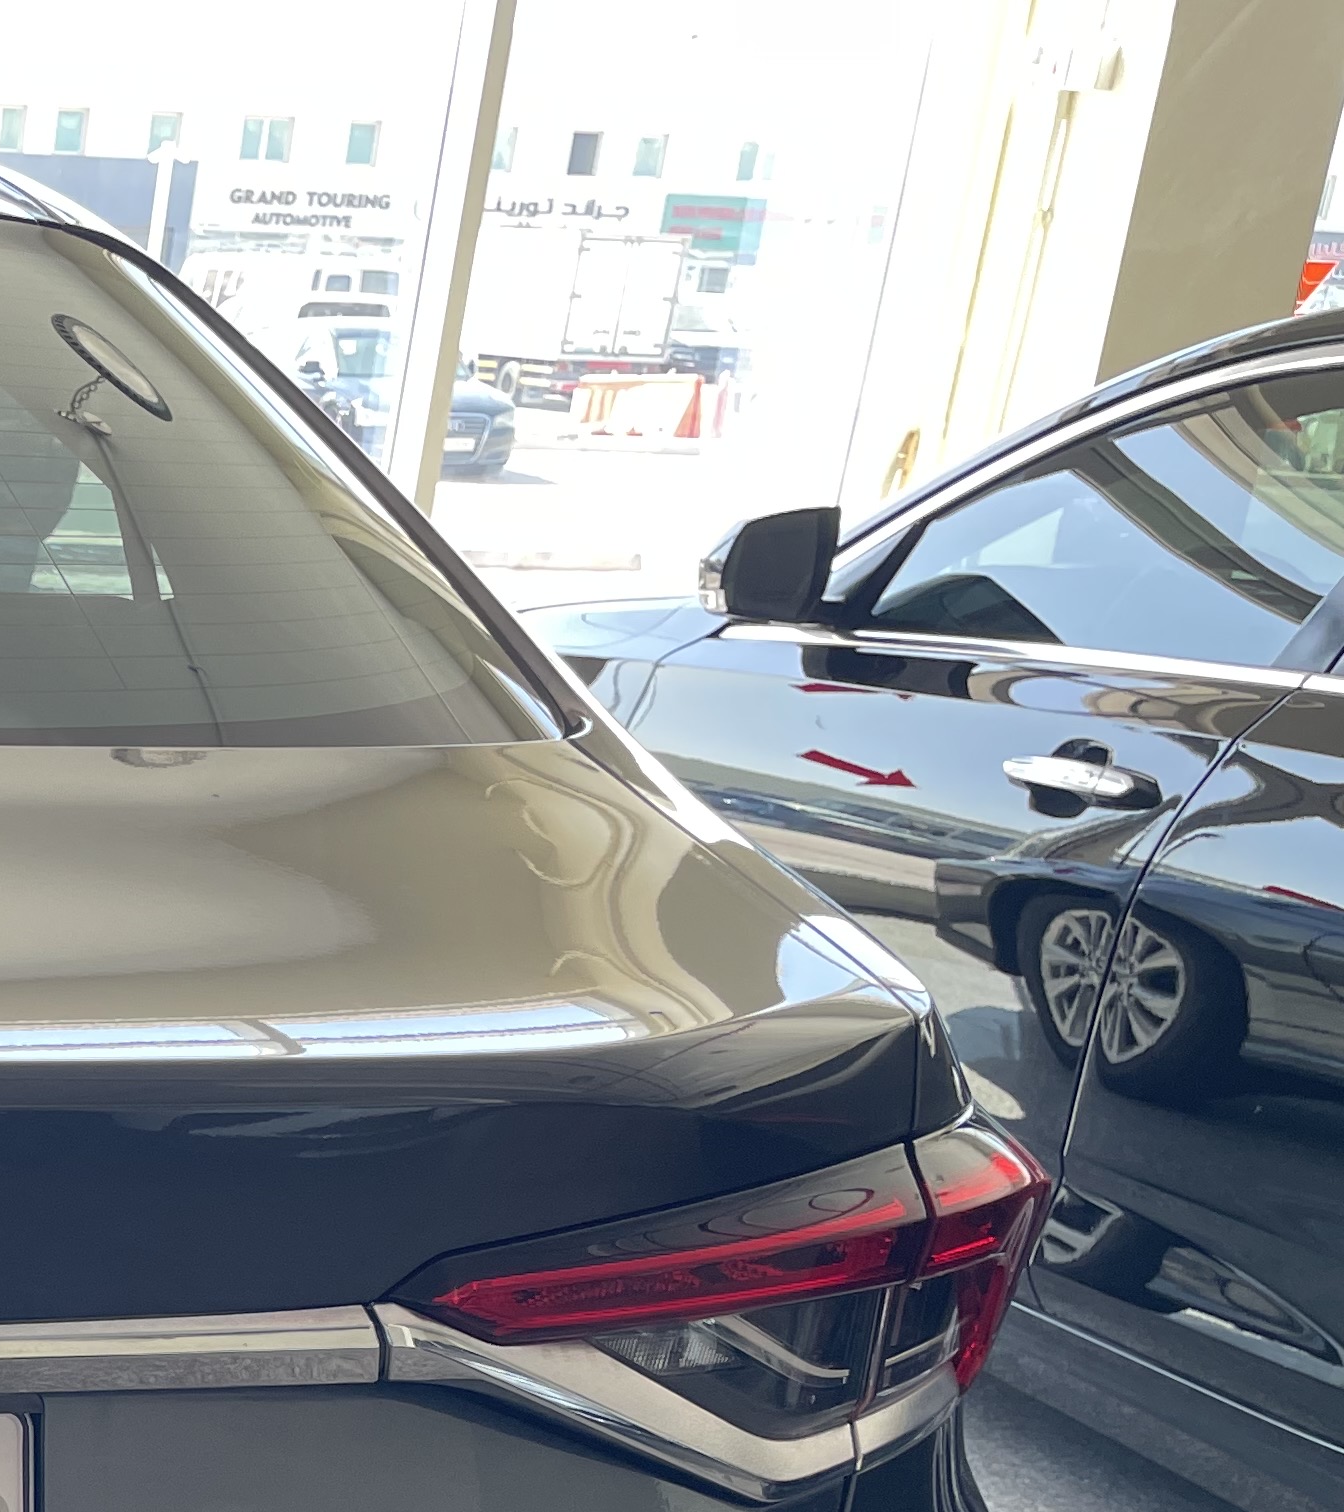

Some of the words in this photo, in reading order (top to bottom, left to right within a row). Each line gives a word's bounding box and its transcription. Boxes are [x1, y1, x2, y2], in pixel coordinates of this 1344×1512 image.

[229, 188, 297, 206] GRAND
[307, 191, 391, 209] TOURING
[251, 212, 352, 228] AUTOMOTIVE
